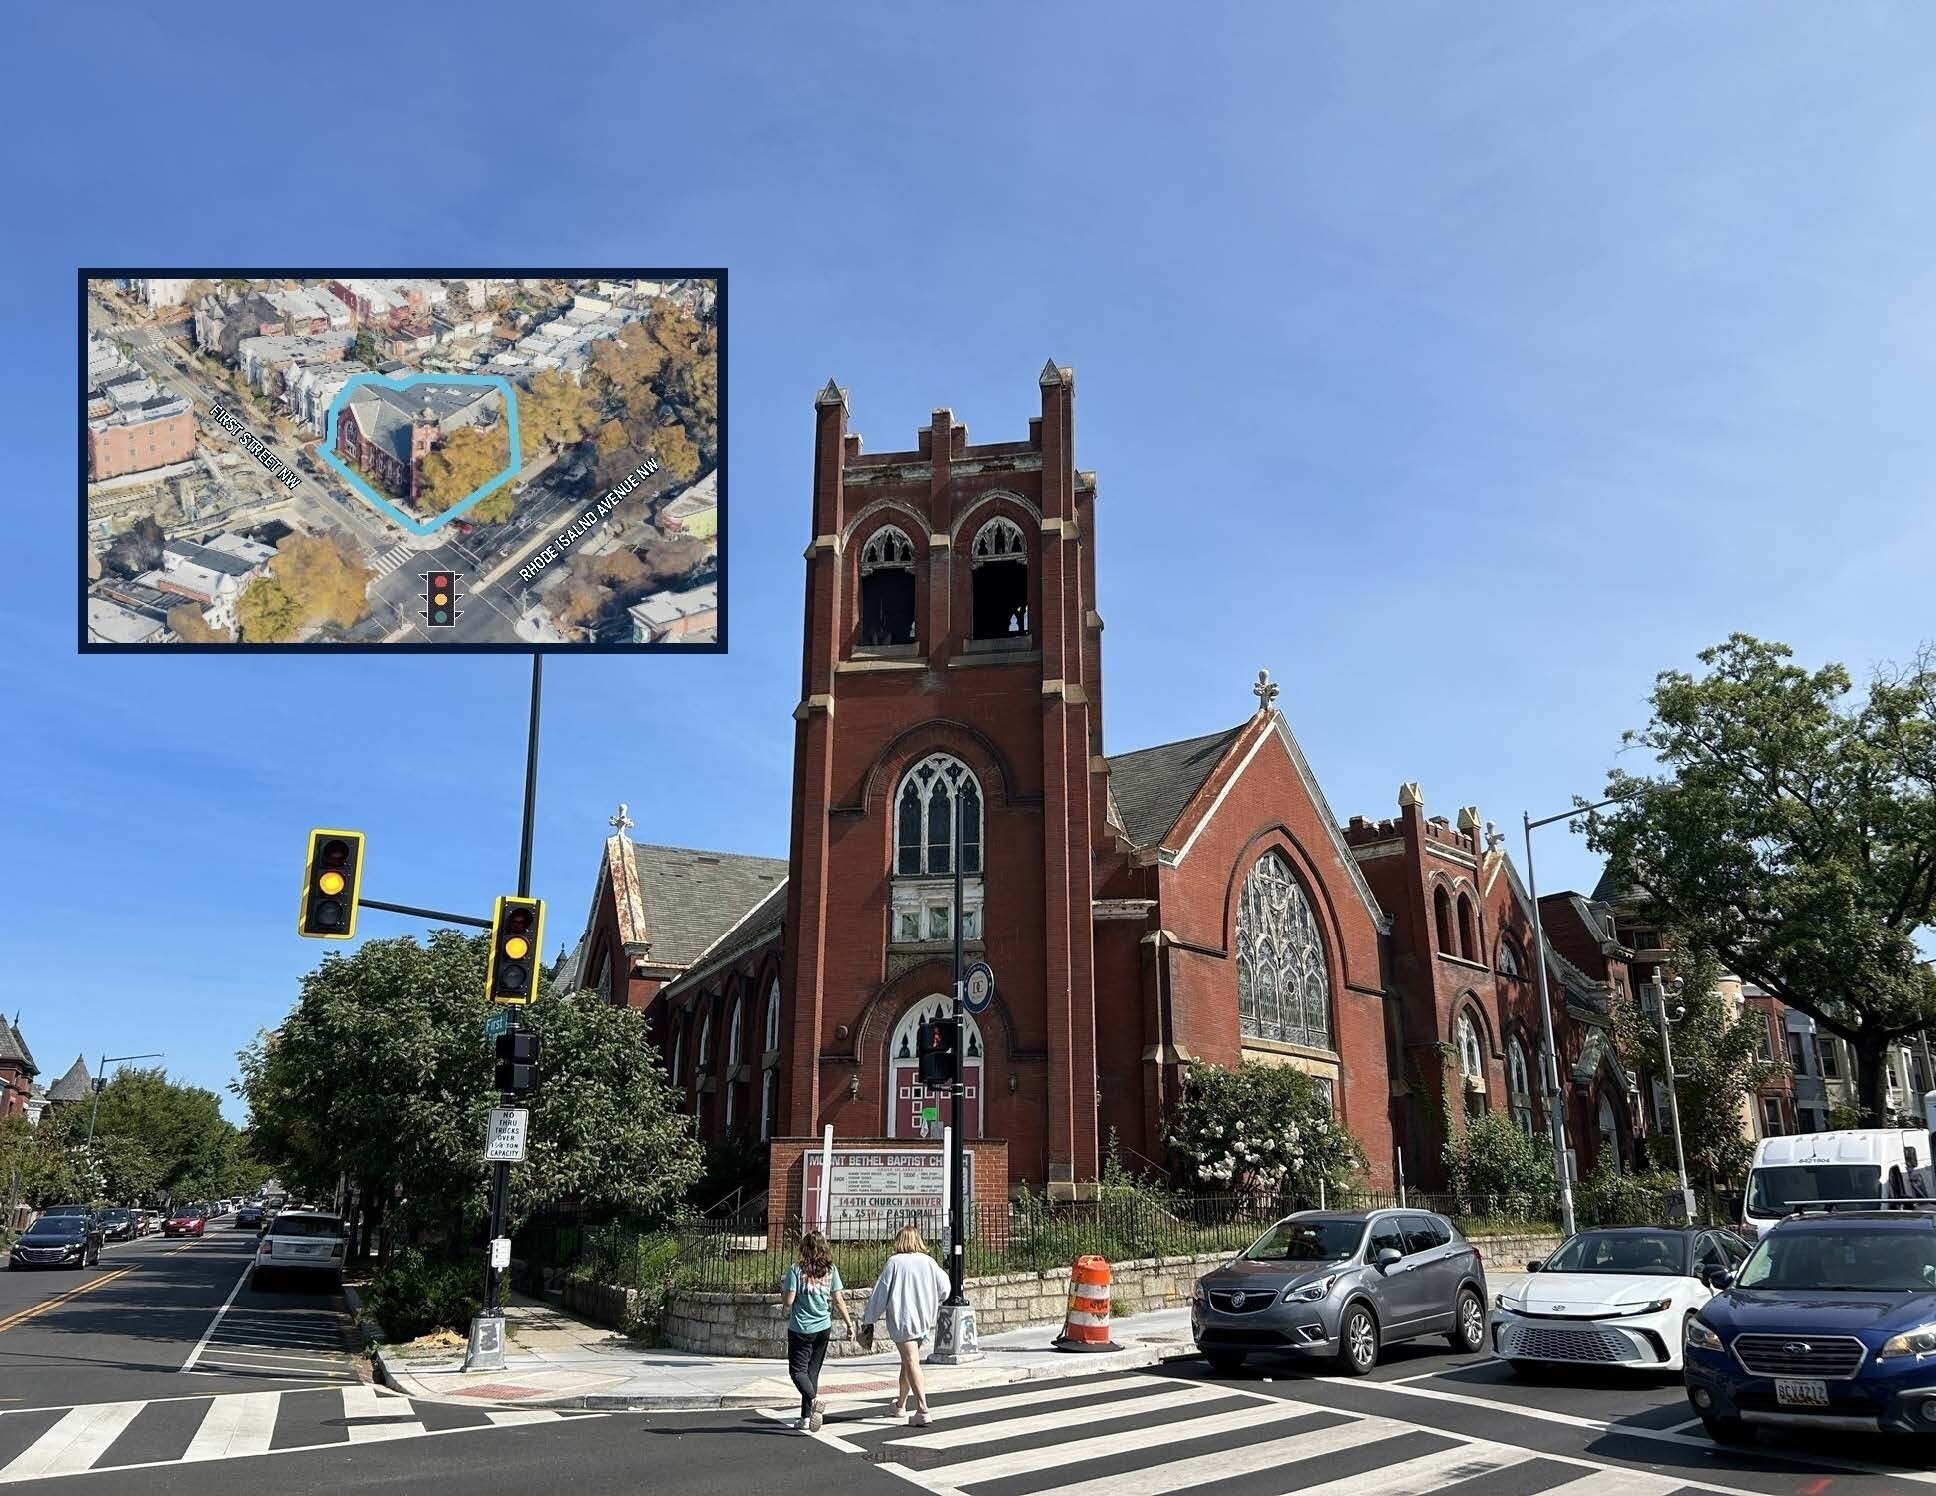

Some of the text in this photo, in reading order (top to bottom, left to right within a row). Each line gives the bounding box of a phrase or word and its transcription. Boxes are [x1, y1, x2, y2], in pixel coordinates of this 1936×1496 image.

[486, 1015, 503, 1032] First
[502, 1111, 515, 1119] NO
[490, 1149, 519, 1157] CAPACITY
[809, 1155, 846, 1166] MONT
[848, 1155, 884, 1166] BETHEL
[887, 1155, 926, 1166] BAPTIST
[839, 1197, 867, 1207] 144TH
[869, 1197, 903, 1207] CHURCH
[842, 1209, 848, 1218] &
[855, 1208, 877, 1218] 25TH
